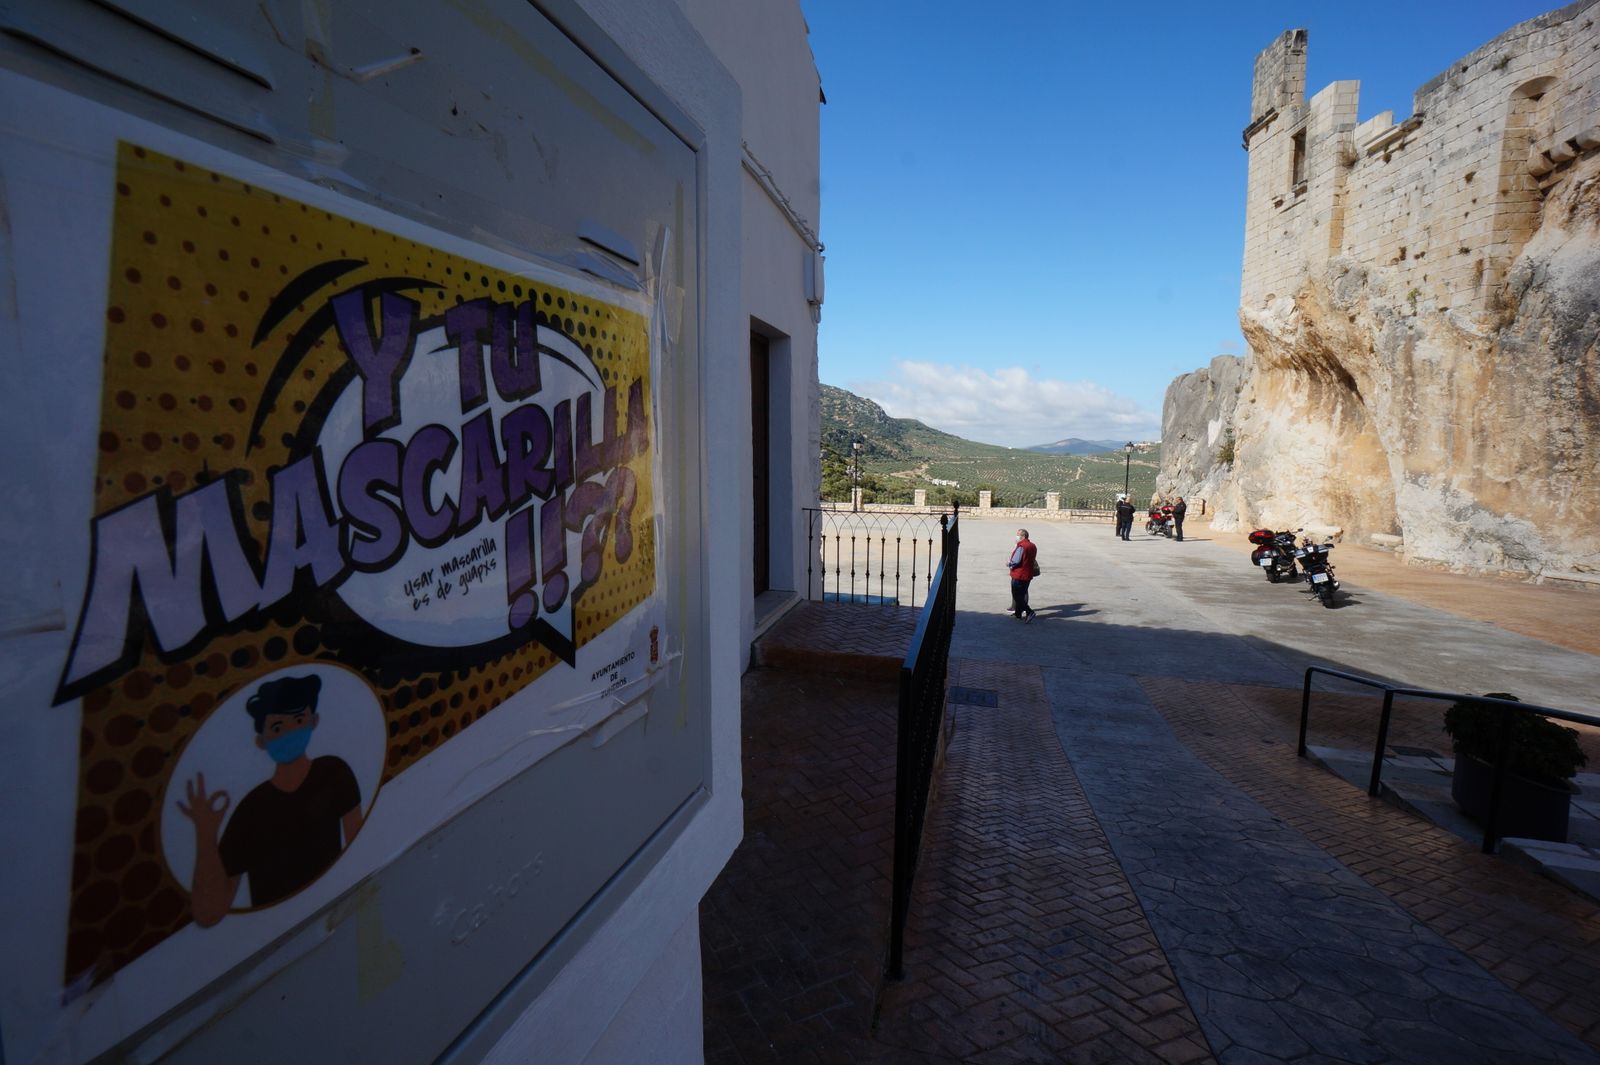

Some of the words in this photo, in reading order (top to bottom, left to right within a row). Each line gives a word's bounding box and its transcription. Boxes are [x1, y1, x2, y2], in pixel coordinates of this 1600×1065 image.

[332, 288, 420, 436] Y
[445, 296, 541, 414] TU
[54, 378, 650, 706] MASCARILLA
[403, 568, 434, 597] usar
[440, 537, 497, 577] mascarilla
[412, 593, 430, 611] es
[437, 579, 452, 600] de
[459, 558, 497, 596] guapxs
[591, 651, 636, 682] AYUNTAMIENTO
[610, 672, 618, 682] DE
